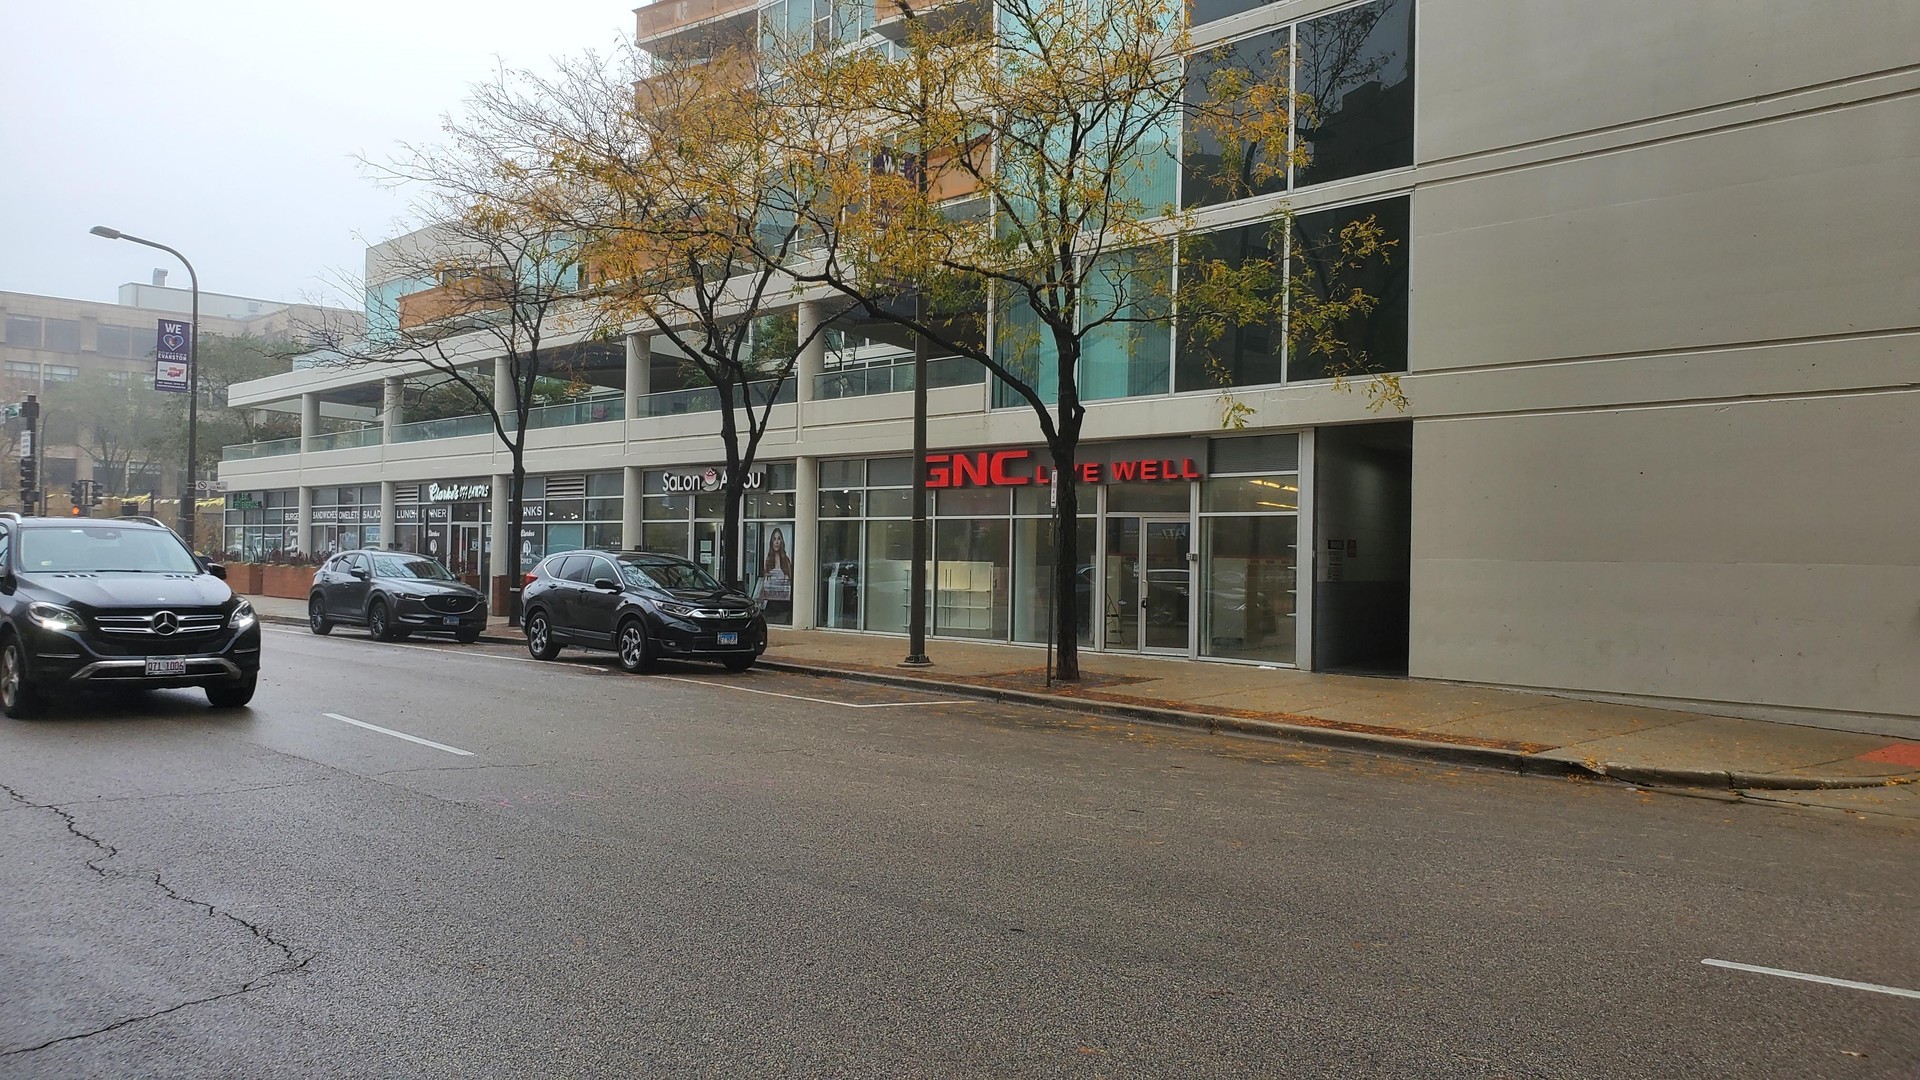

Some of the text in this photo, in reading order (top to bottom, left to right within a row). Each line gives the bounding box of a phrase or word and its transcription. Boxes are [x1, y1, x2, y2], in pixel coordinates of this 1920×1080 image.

[165, 323, 182, 334] WE
[926, 451, 1028, 487] GNC
[1036, 458, 1199, 483] LE WELL
[429, 483, 459, 501] Clarke's
[285, 512, 300, 521] BURGE
[313, 511, 337, 519] SANDWICHES
[339, 511, 359, 520] OMELETS
[396, 509, 417, 519] LUNCH
